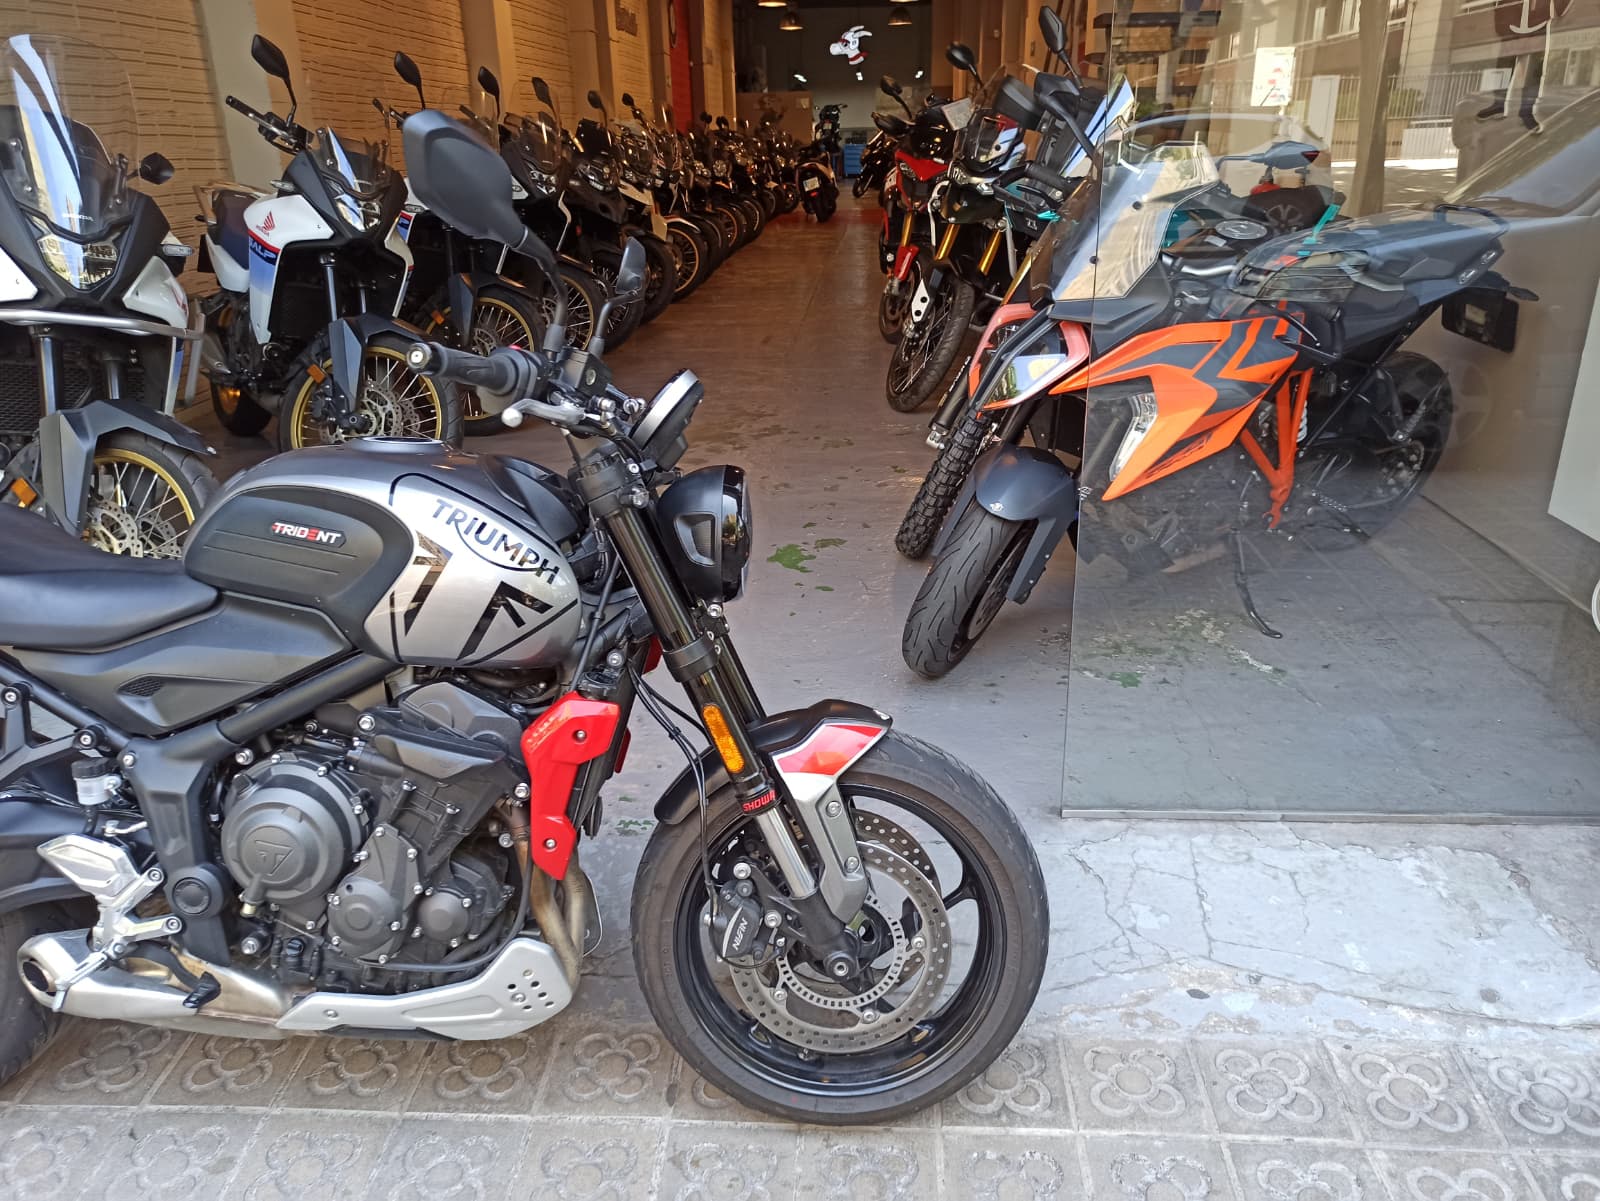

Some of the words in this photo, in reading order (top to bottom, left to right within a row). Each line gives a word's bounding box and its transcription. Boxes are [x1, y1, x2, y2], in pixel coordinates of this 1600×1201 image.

[271, 522, 342, 544] TRIDENT
[432, 498, 560, 585] TRIUMPH
[732, 917, 748, 951] NISSIN
